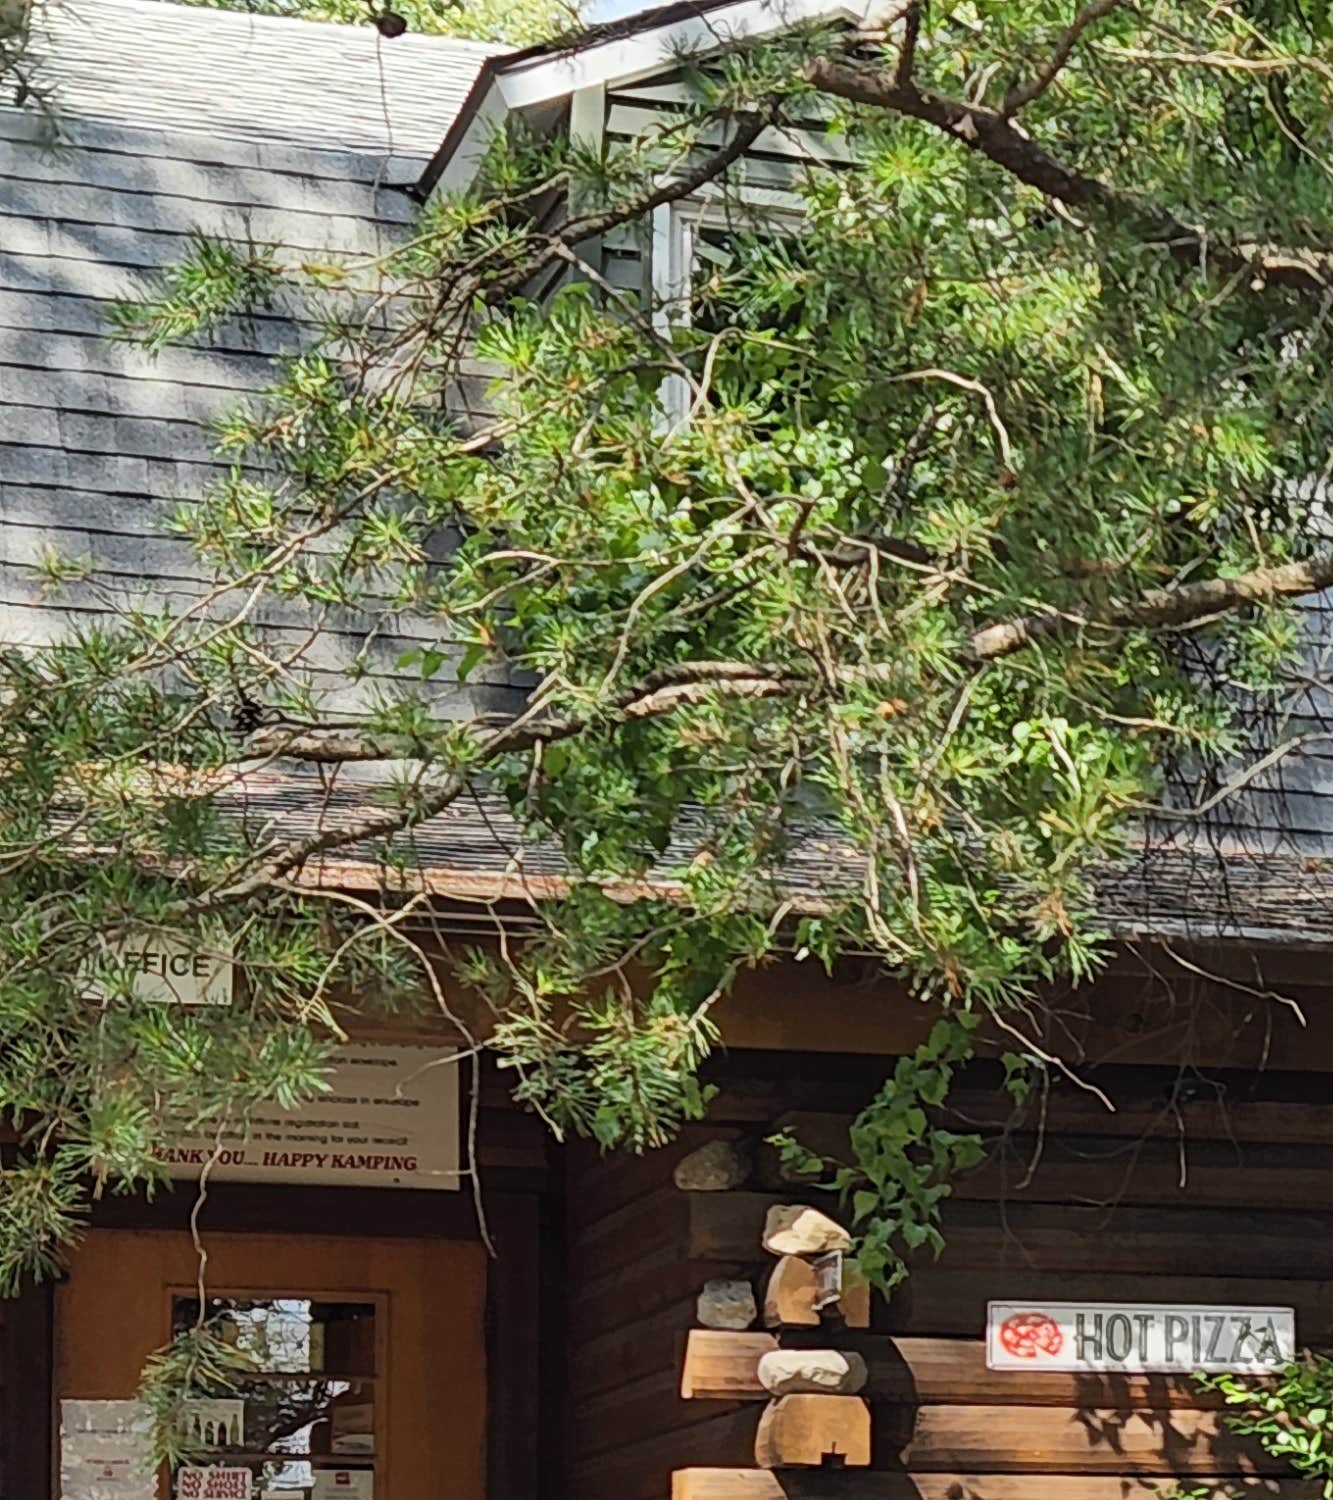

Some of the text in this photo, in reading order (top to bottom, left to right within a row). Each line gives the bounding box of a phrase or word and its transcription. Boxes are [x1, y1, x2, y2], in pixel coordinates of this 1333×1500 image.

[103, 951, 210, 977] FFICE
[263, 1151, 328, 1169] HAPPY
[330, 1153, 417, 1172] KAMPING
[1074, 1312, 1286, 1366] HOT PIZZA
[183, 1471, 203, 1480] NO
[183, 1480, 201, 1489] NO
